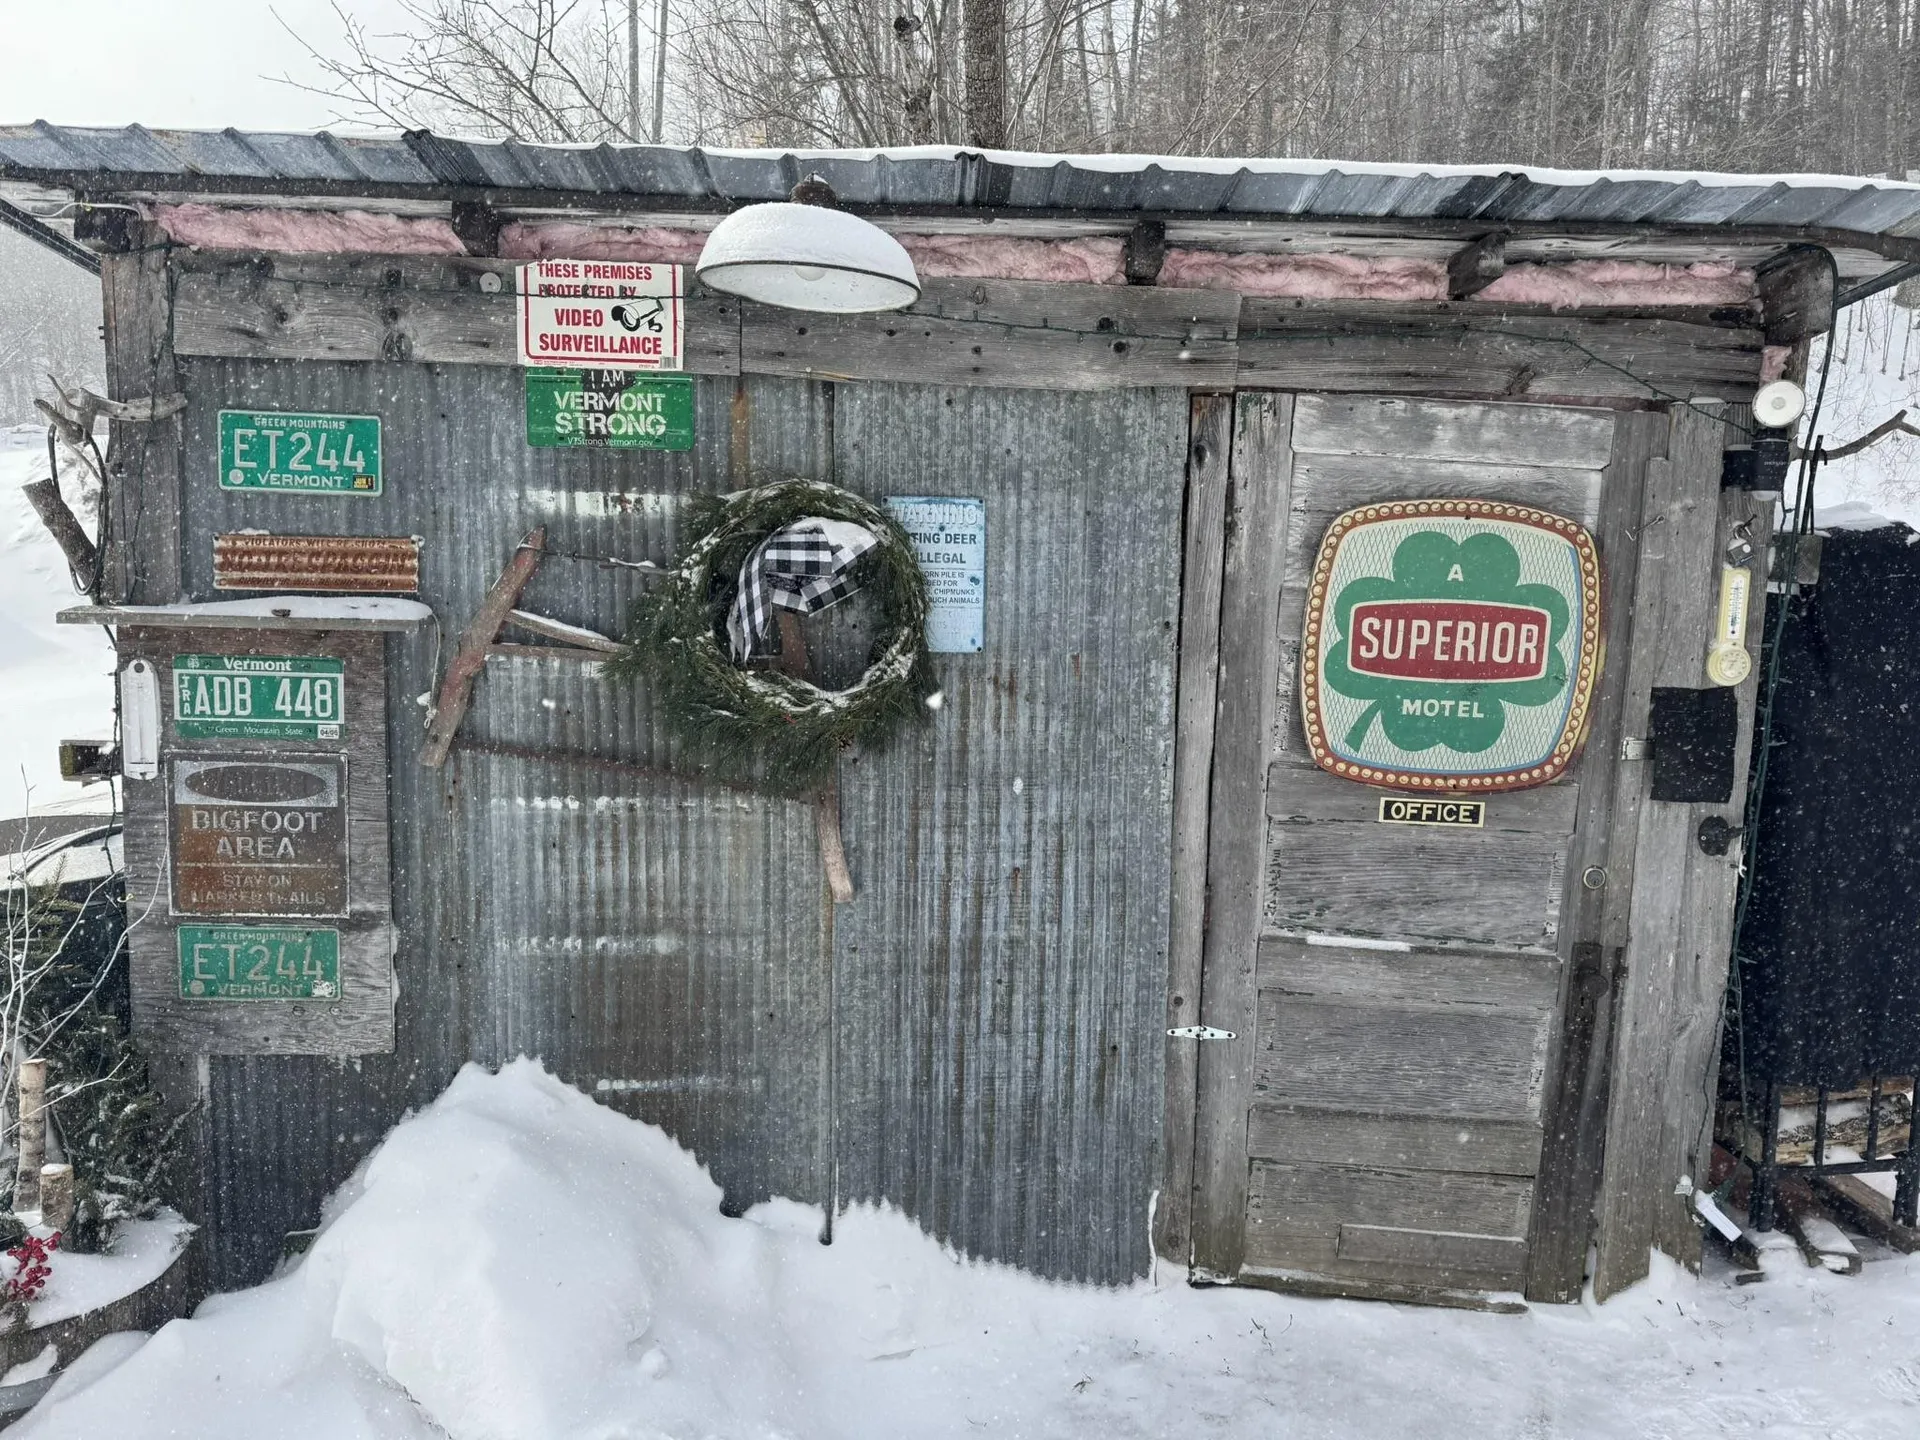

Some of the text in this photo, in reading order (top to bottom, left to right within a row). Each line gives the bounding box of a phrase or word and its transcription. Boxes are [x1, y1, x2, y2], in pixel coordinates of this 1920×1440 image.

[537, 263, 652, 280] THESE PREMISES
[554, 308, 604, 327] VIDEO
[539, 333, 662, 355] SURVEILLANCE
[601, 370, 625, 388] AM
[553, 391, 666, 412] VERMONT
[254, 417, 346, 430] GREEN MOUNTAINS
[554, 412, 667, 436] STRONG
[234, 429, 366, 472] ET244
[257, 472, 343, 488] VERMONT
[945, 533, 977, 545] DEER
[1447, 564, 1464, 581] A
[949, 597, 980, 605] ANIMALS
[1359, 617, 1539, 664] SUPERIOR
[223, 657, 292, 671] Vermont
[195, 677, 252, 716] ADB
[275, 678, 332, 718] 448
[1402, 699, 1484, 718] MOTEL
[215, 726, 238, 734] Green
[243, 727, 280, 735] Mountain
[192, 809, 324, 834] BIGFOOT
[1390, 802, 1475, 823] OFFICE
[216, 837, 296, 859] AREA
[222, 874, 292, 887] STAY ON
[213, 932, 245, 941] GREEN
[193, 943, 324, 981] ET244
[217, 983, 304, 996] VERMONT
